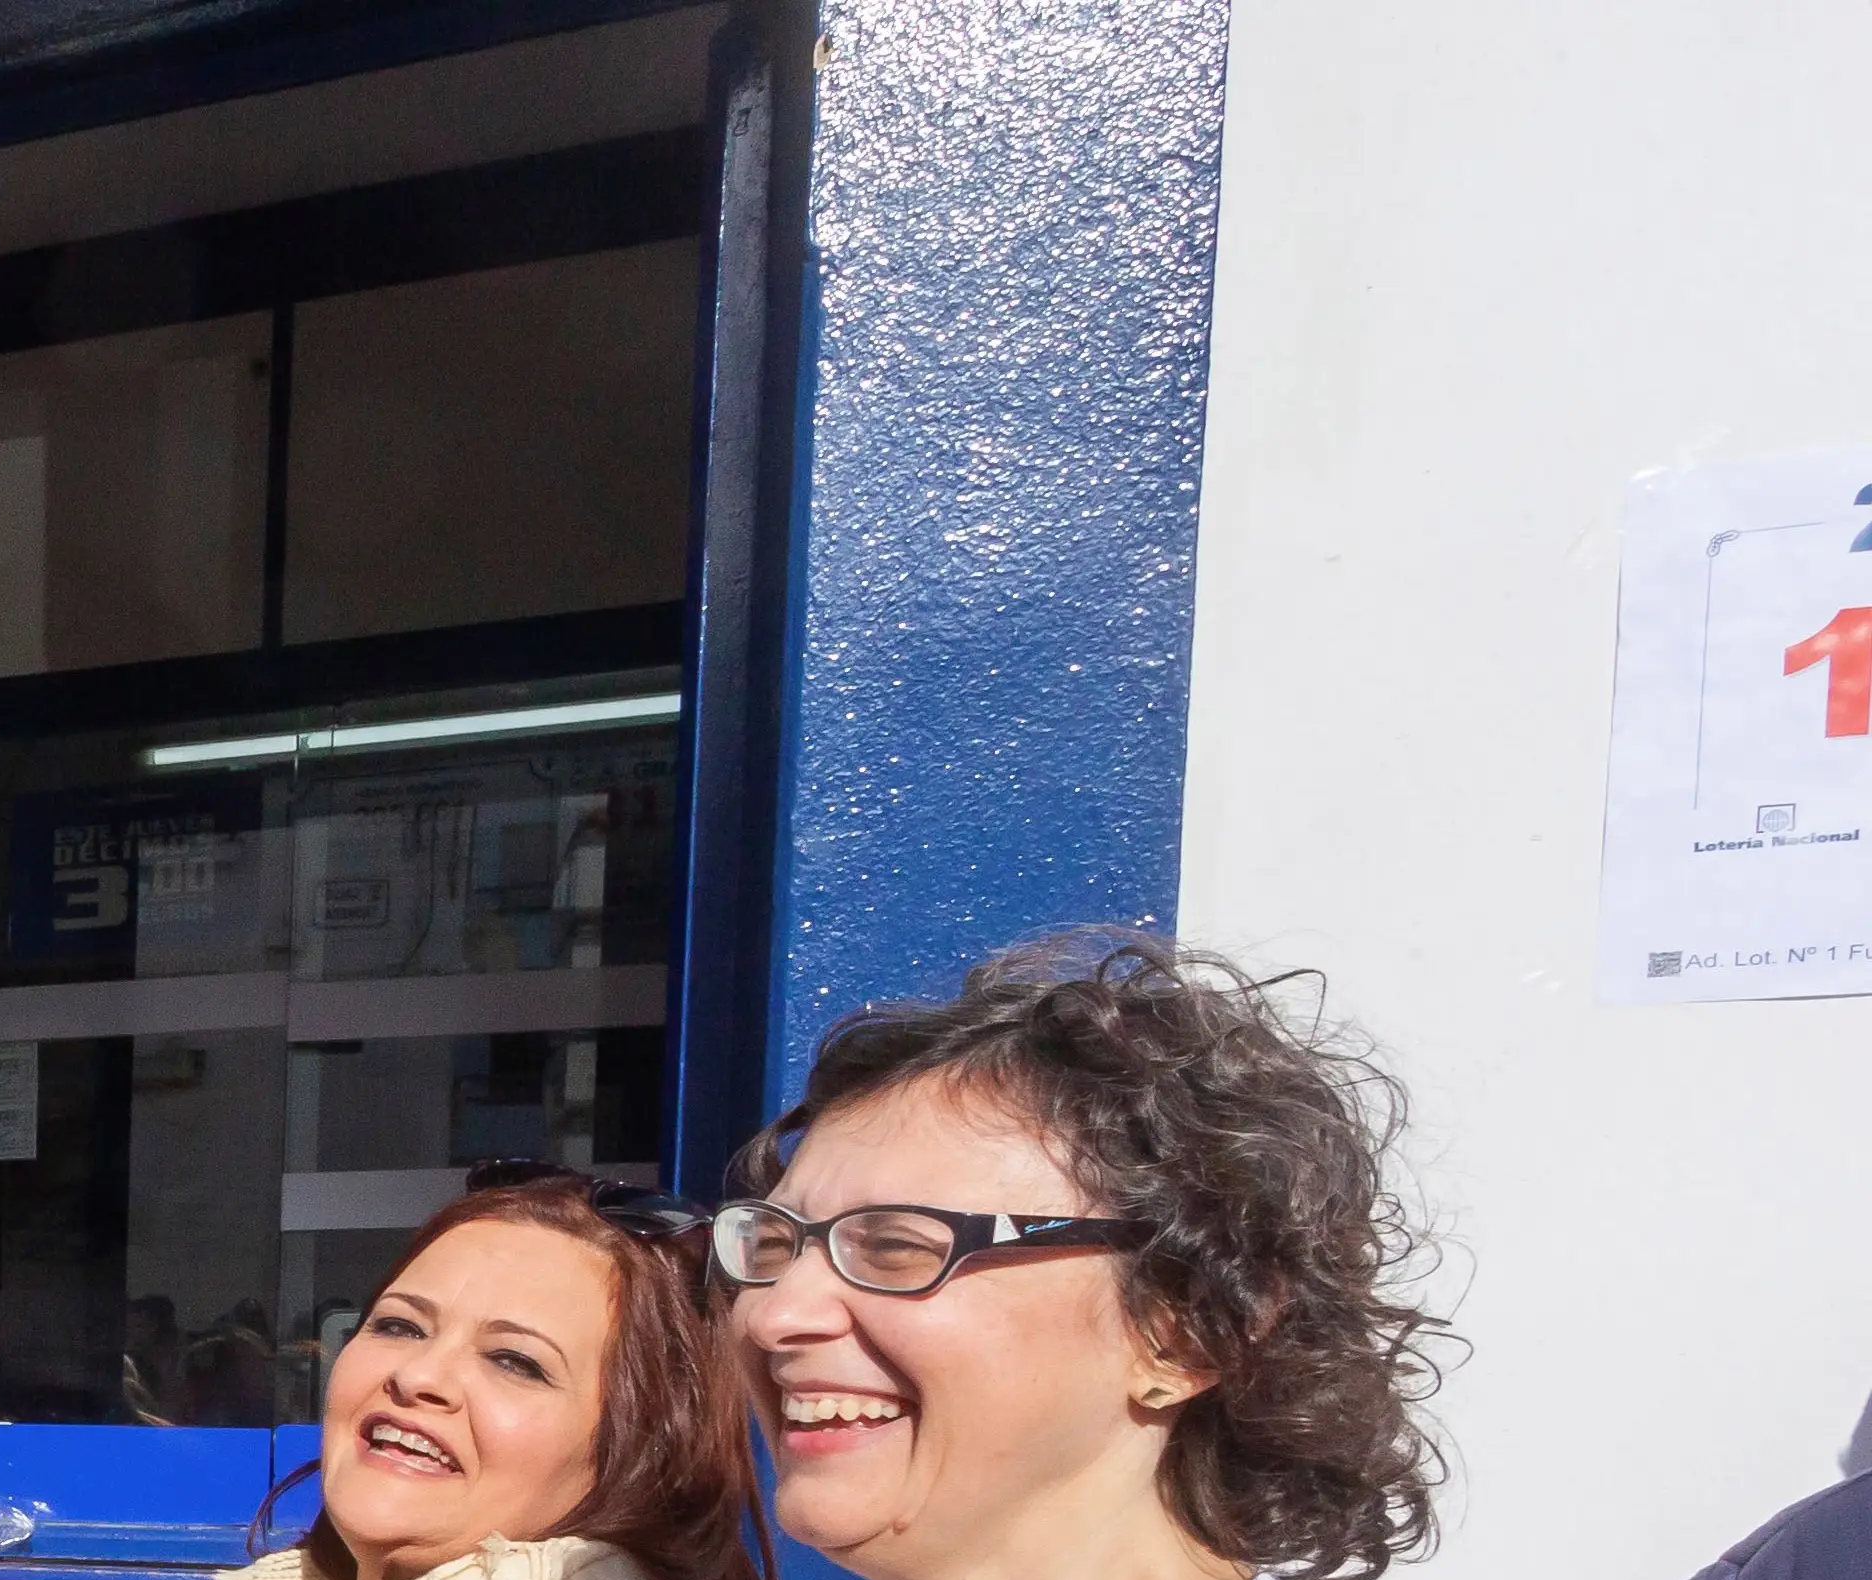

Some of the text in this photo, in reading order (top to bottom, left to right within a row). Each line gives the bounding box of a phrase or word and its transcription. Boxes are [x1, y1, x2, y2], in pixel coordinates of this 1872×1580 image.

[1693, 828, 1860, 853] Lotería Nacional
[51, 865, 129, 931] 3
[1684, 952, 1724, 970] Ad.
[1734, 949, 1778, 967] Lot.
[1787, 946, 1817, 963] Nº
[1827, 946, 1836, 960] 1
